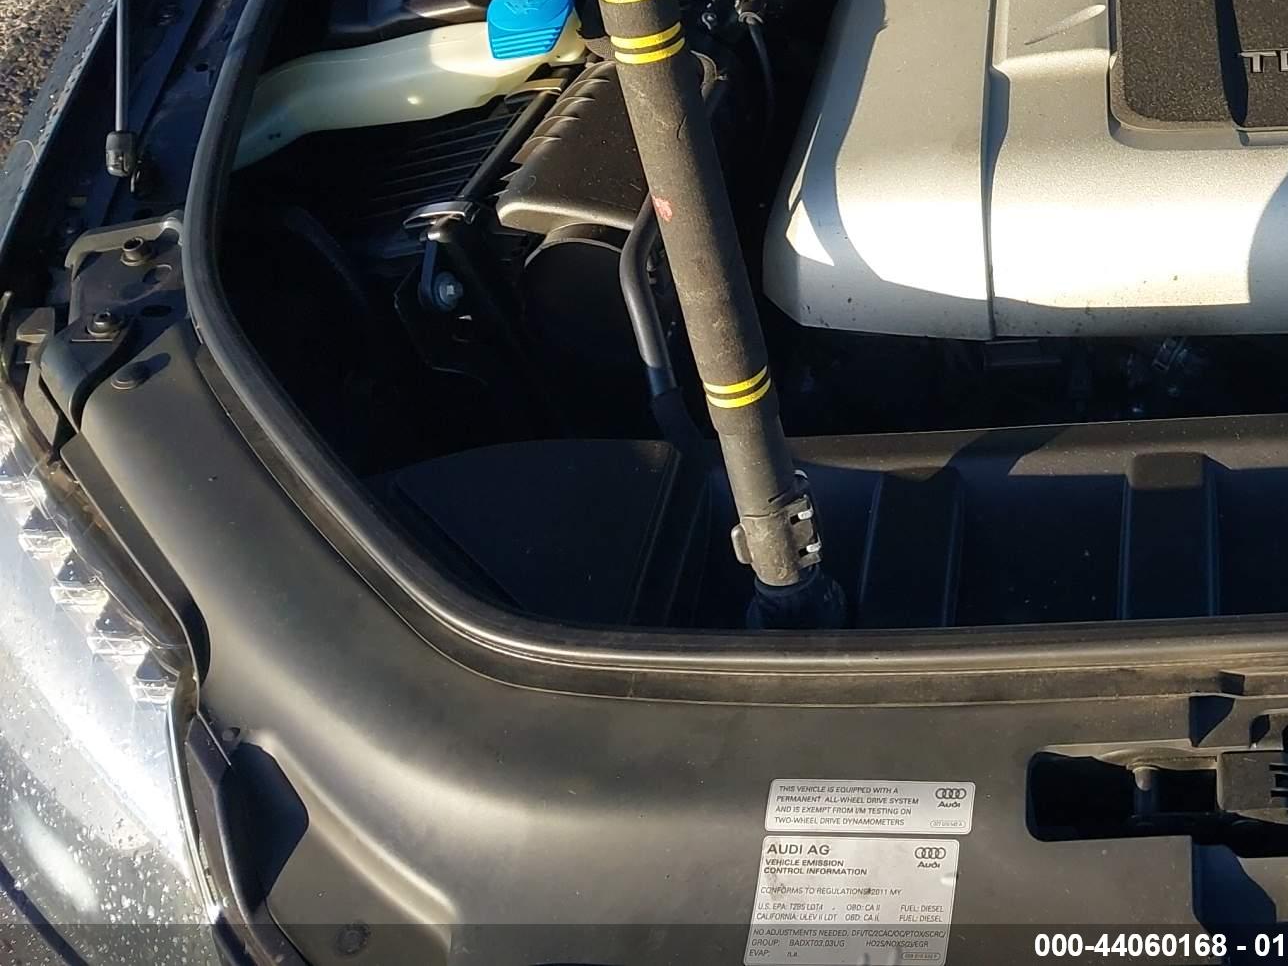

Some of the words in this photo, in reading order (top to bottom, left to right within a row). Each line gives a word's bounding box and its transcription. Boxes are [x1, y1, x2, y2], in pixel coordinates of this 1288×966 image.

[835, 786, 871, 794] EQUIPPED
[825, 796, 865, 804] ALL-WHEEL
[889, 797, 919, 805] SYSTEM
[937, 800, 961, 808] Audi
[801, 806, 831, 814] EXEMPT
[867, 807, 898, 815] TESTING
[774, 816, 818, 825] TWO-WHEEL
[819, 817, 841, 825] DRIVE
[842, 818, 905, 826] DYNAMOMETERS
[766, 843, 803, 855] AUDI
[802, 859, 844, 867] EMISSION
[763, 867, 805, 875] CONTROL
[806, 867, 868, 876] INFORMATION
[760, 886, 804, 894] CONFORMS
[900, 904, 919, 912] FUEL:
[920, 904, 944, 913] DIESEL
[899, 914, 918, 922] FUEL:
[919, 914, 943, 922] DIESEL
[765, 929, 817, 937] ADJUSTMENTS
[751, 938, 781, 946] GROUP:
[749, 949, 771, 957] EVAP:
